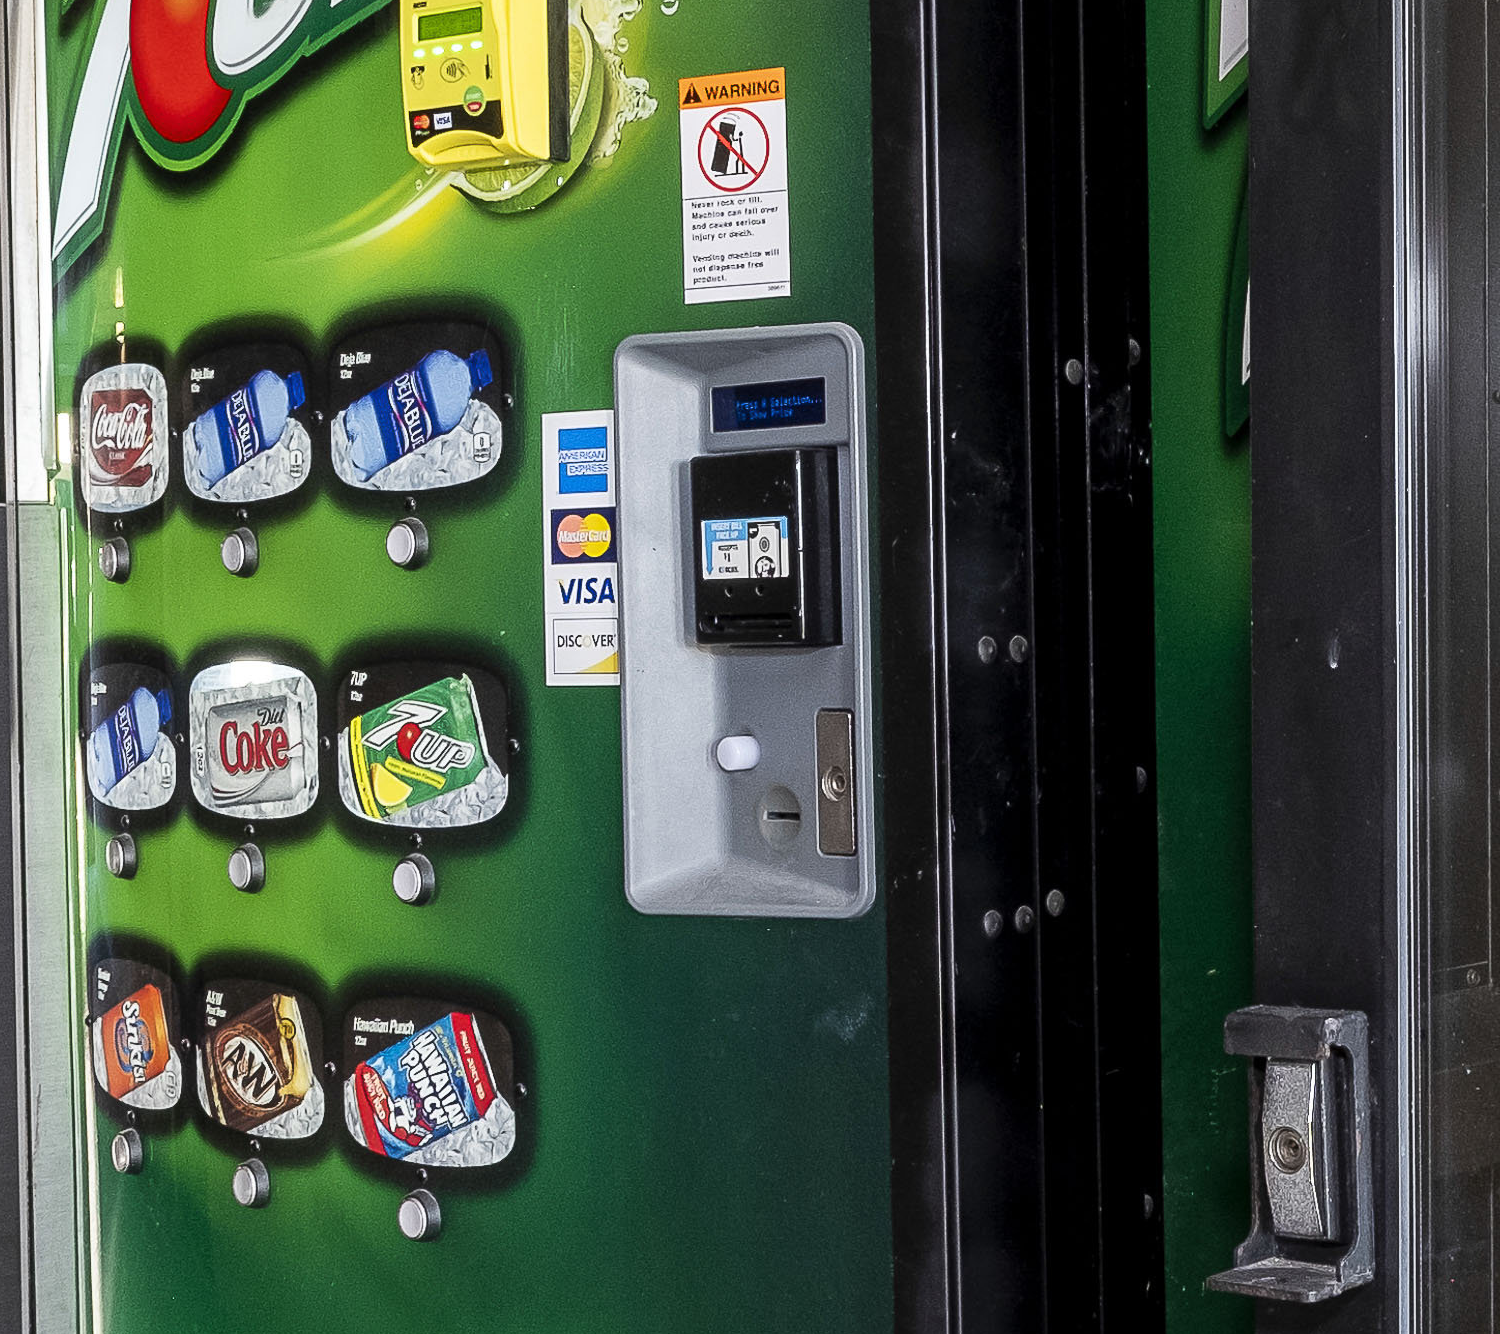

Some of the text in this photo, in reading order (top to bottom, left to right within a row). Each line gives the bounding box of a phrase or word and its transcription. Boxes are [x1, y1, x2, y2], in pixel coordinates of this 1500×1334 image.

[704, 79, 780, 101] WARNING
[559, 451, 605, 462] AMERICAN
[568, 464, 609, 474] EXPRESS
[558, 529, 611, 543] MasterCard
[558, 578, 615, 604] VISA
[557, 634, 614, 648] DISCOVER
[351, 670, 367, 686] 7UP
[257, 707, 285, 727] Diet
[361, 700, 475, 773] 7UP
[220, 722, 289, 775] Coke
[354, 1017, 414, 1035] Hawaiian Punch
[401, 1049, 448, 1124] PUNCH
[413, 1030, 468, 1128] HAWAIIAN
